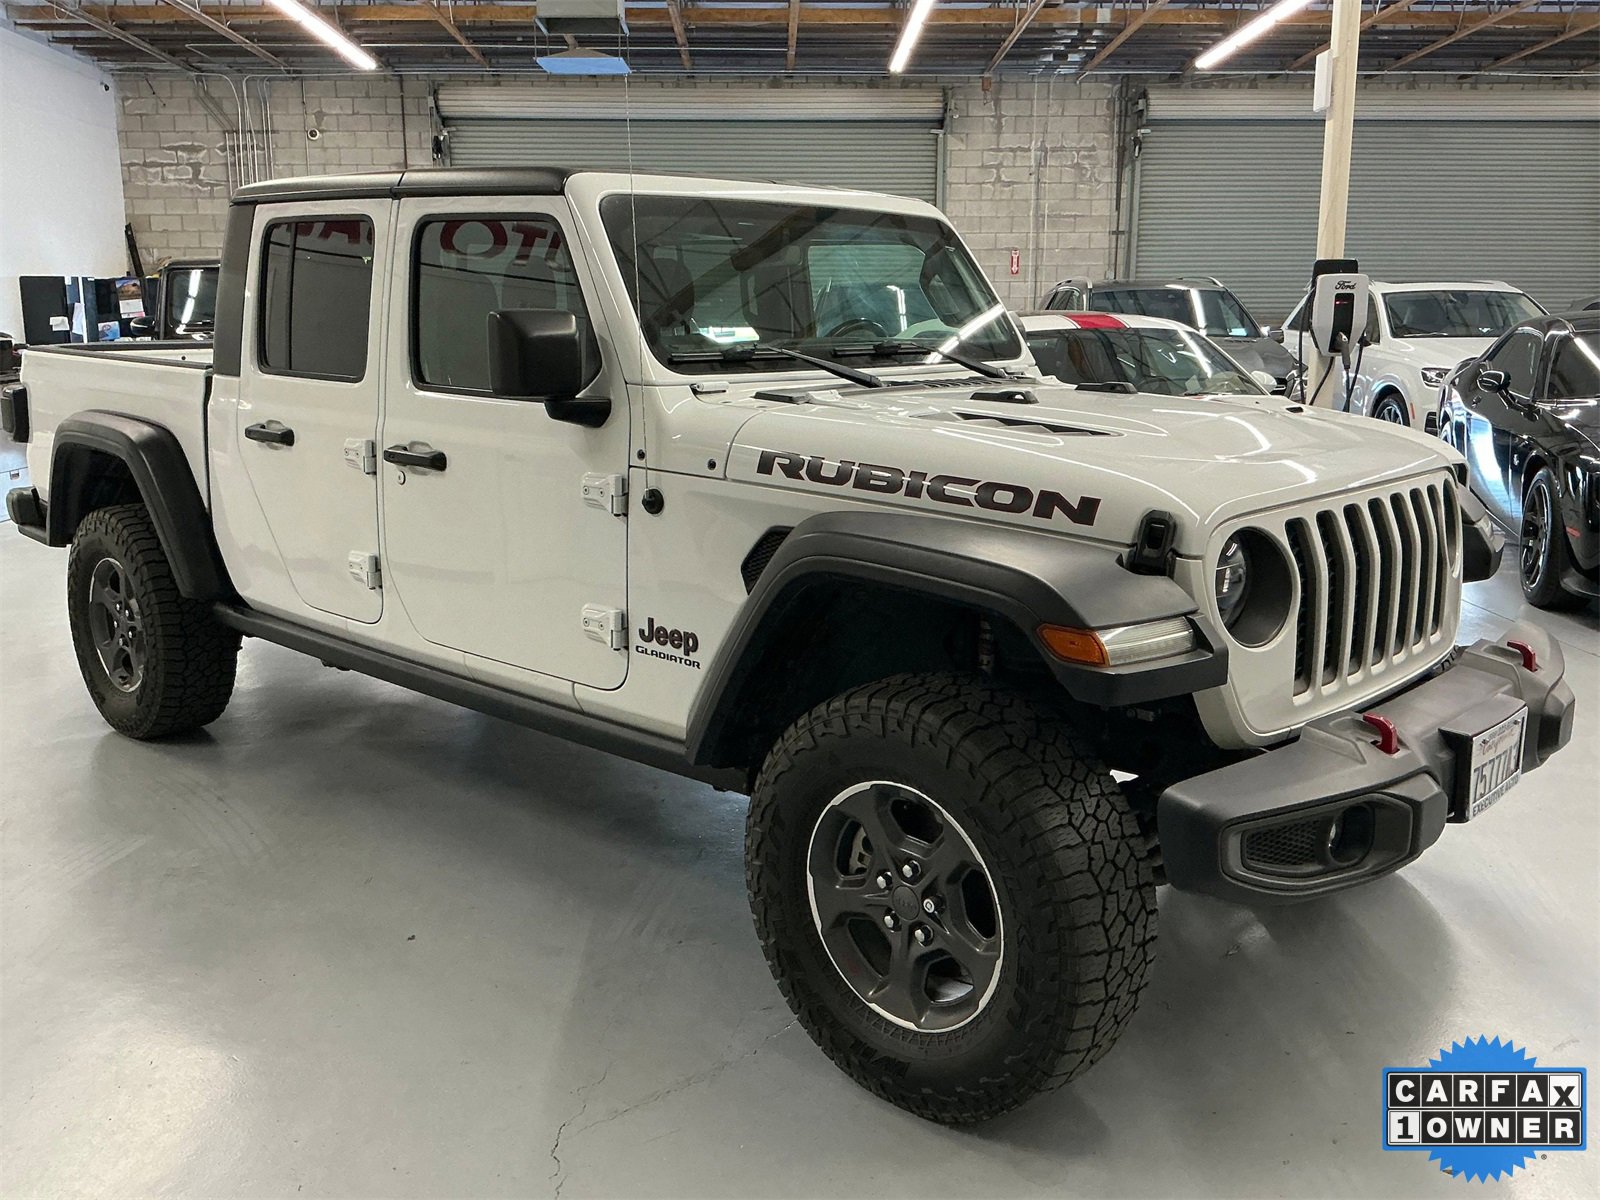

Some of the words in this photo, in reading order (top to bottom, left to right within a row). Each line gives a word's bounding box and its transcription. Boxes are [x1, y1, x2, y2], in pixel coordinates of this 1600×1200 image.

[1335, 280, 1356, 290] Ford
[756, 450, 1101, 526] RUBICON
[638, 616, 698, 656] Jeep
[635, 645, 701, 669] GLADIATOR
